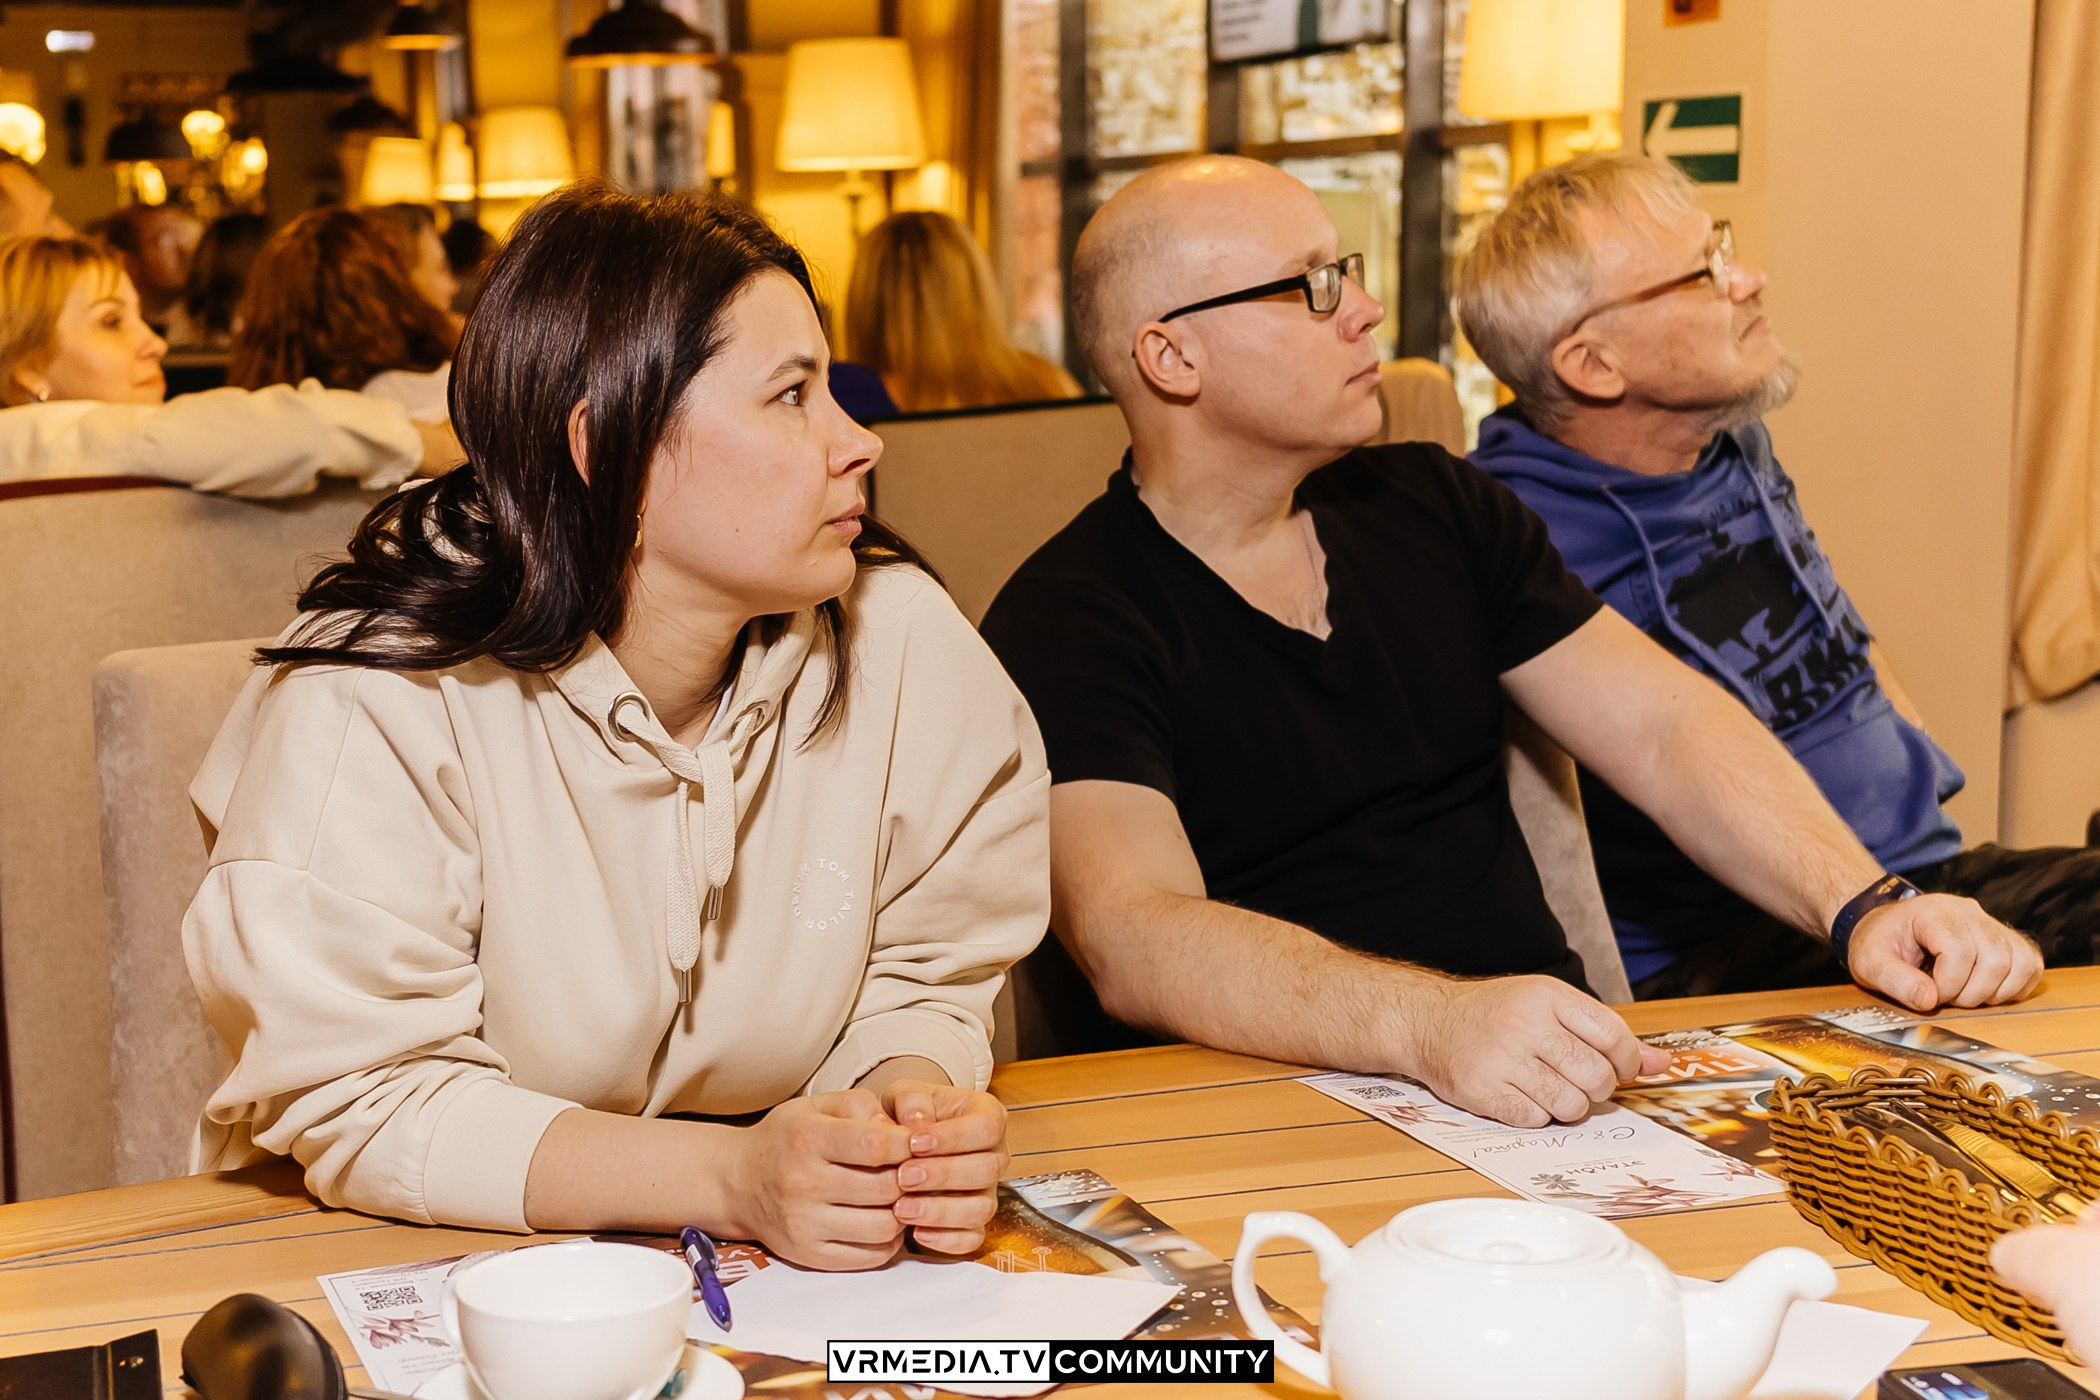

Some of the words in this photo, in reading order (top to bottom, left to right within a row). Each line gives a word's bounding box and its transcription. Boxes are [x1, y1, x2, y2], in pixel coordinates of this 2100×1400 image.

[817, 858, 851, 882] TOM
[804, 889, 855, 931] TAILOR
[1471, 1133, 1584, 1158] Марта!
[1565, 1159, 1648, 1176] ЭТАЛОН
